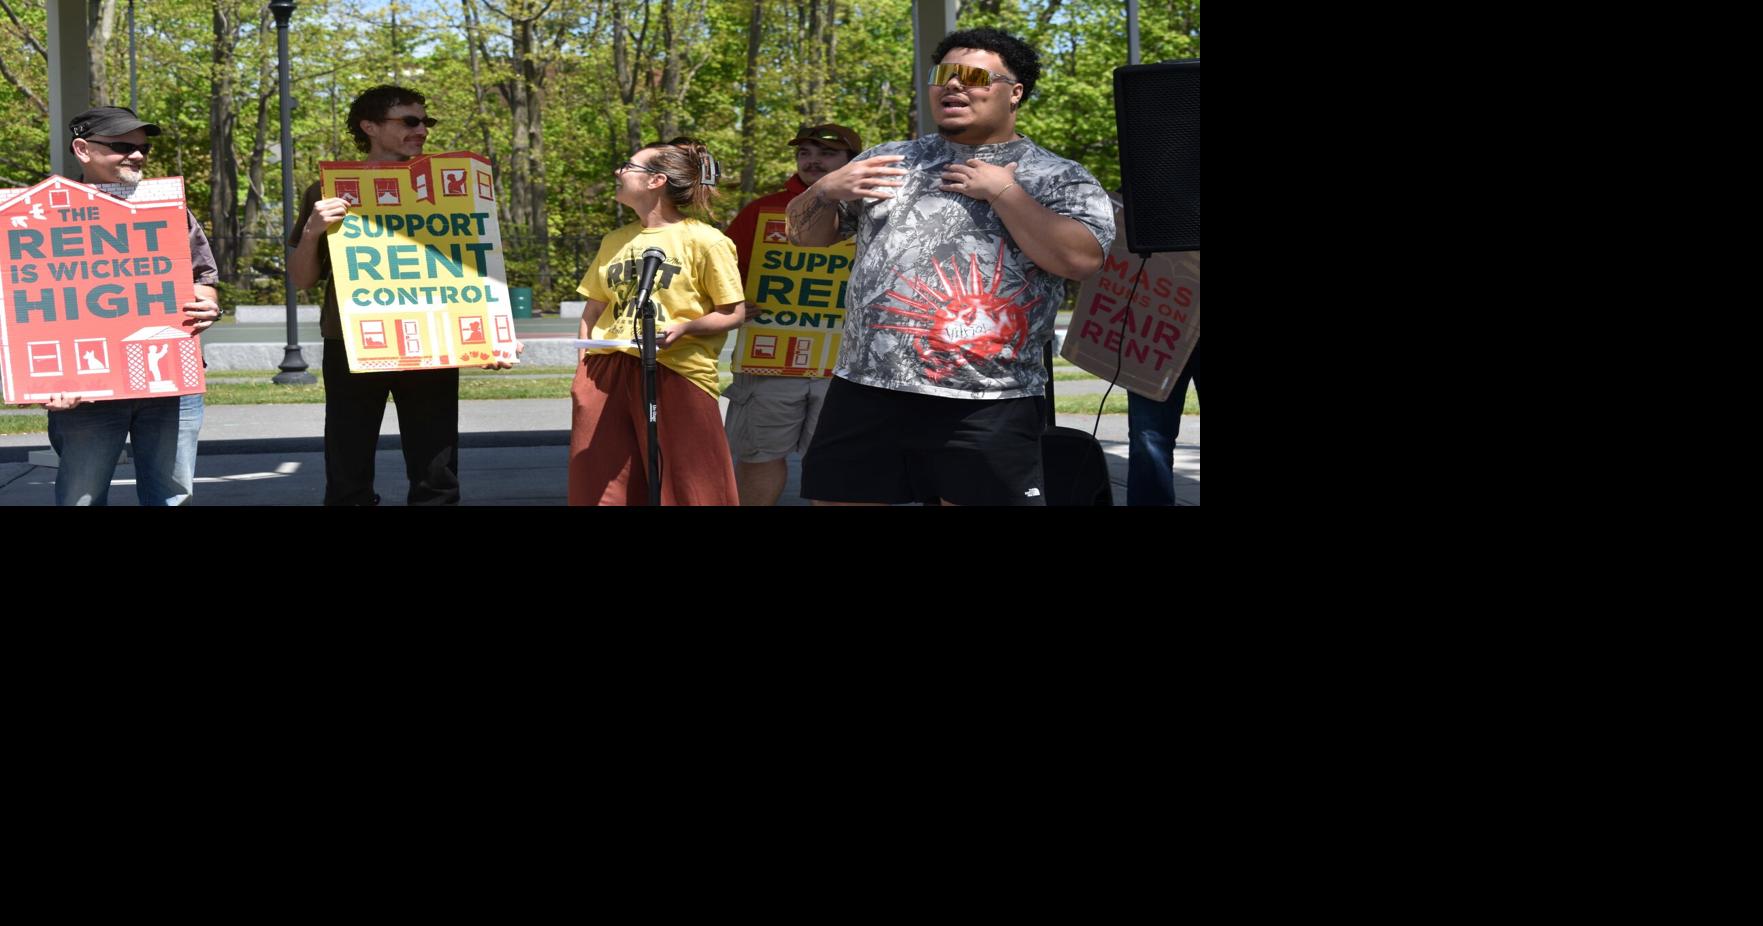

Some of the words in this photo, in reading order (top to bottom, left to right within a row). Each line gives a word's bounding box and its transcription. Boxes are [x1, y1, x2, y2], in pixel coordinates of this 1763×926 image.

[57, 206, 100, 222] THE
[343, 212, 490, 239] SUPPORT
[7, 220, 168, 260] RENT
[10, 263, 39, 284] IS
[49, 255, 173, 282] WICKED
[345, 242, 494, 281] RENT
[761, 250, 856, 275] SUPP
[1104, 254, 1193, 308] MASS
[12, 280, 178, 324] HIGH
[351, 285, 499, 307] CONTROL
[1100, 278, 1150, 308] RUNS
[1158, 304, 1188, 324] ON
[753, 309, 845, 329] CONT
[1089, 293, 1181, 350] FAIR
[1080, 320, 1172, 371] RENT
